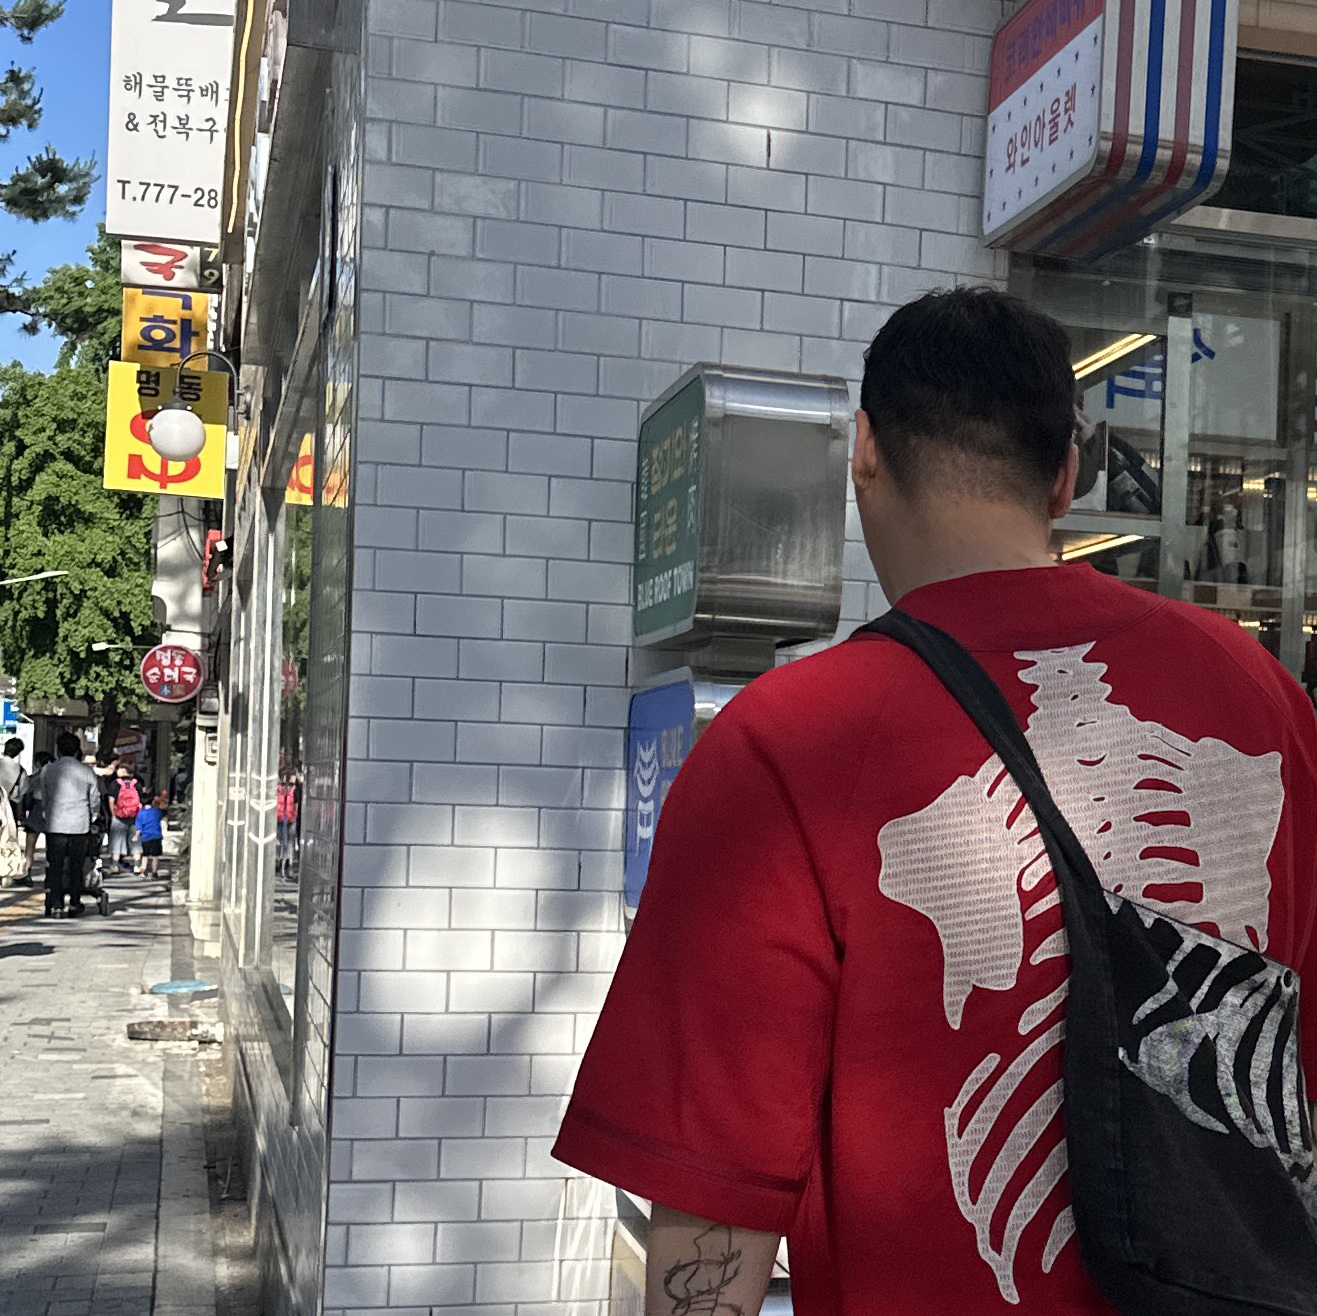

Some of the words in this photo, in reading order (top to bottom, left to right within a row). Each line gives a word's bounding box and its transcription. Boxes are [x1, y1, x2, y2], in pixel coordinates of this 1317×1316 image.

[122, 71, 229, 107] 해물뚝배
[125, 112, 140, 132] &
[146, 111, 227, 144] 전복구
[1005, 82, 1077, 174] 와인아울렛
[654, 569, 673, 603] ROOF
